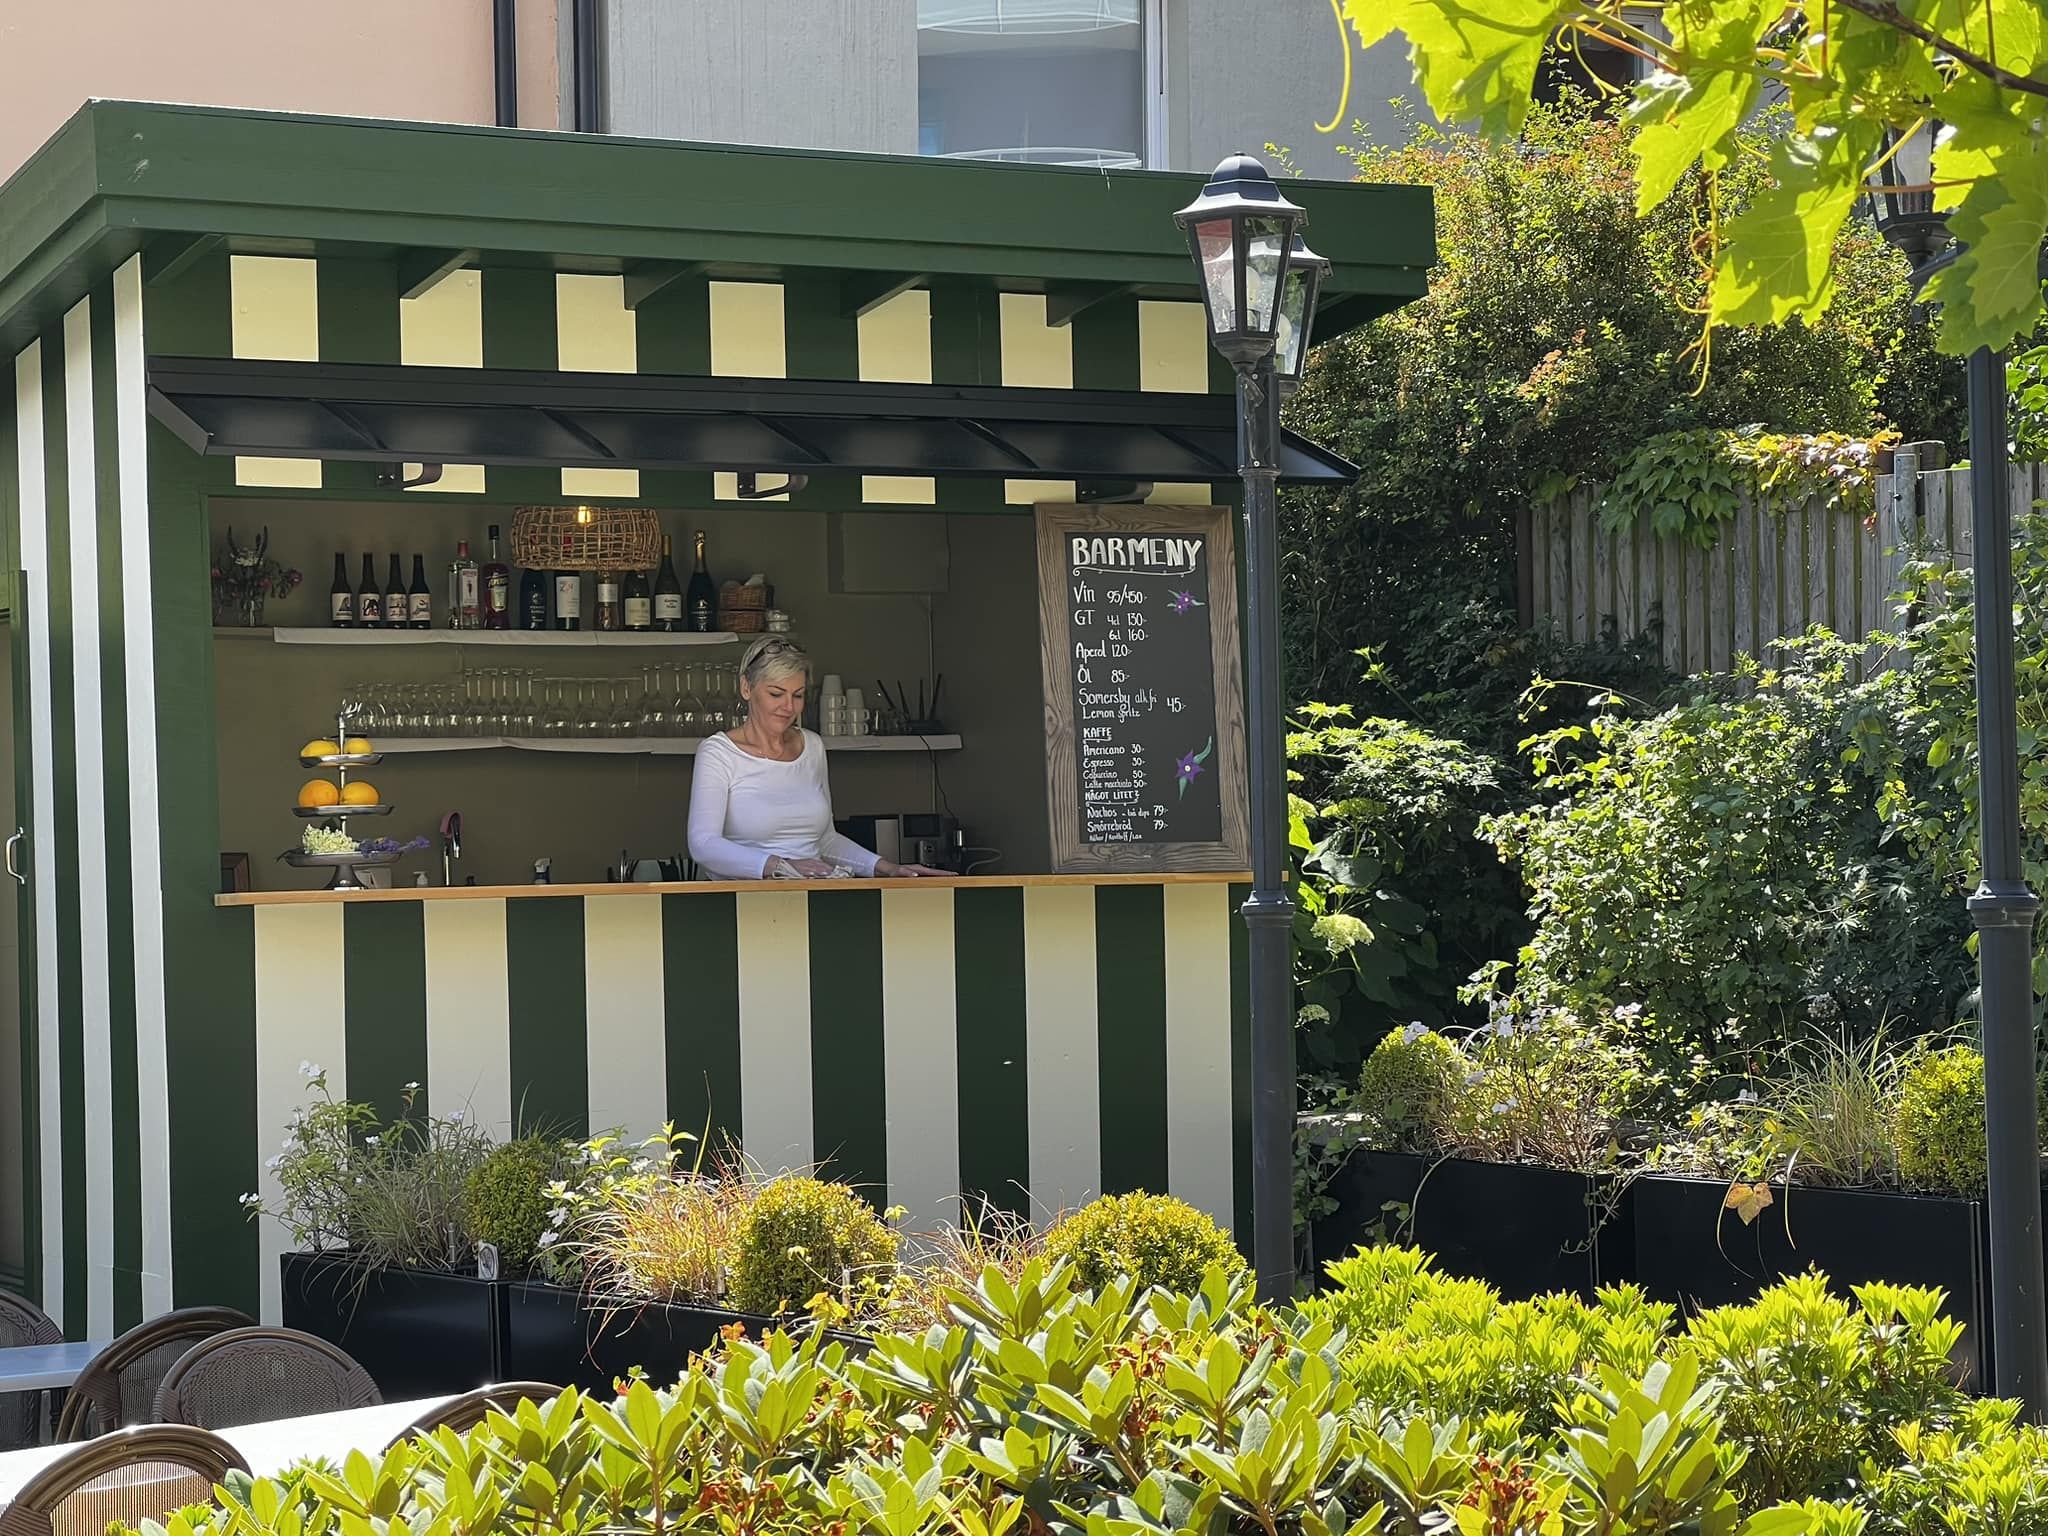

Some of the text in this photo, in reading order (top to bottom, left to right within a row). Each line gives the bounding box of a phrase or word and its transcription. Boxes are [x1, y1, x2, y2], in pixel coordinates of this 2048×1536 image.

[1072, 537, 1202, 566] BARMENY
[1073, 580, 1095, 604] Vin
[1074, 609, 1096, 625] GT
[1075, 640, 1107, 664] Aperol
[1077, 663, 1093, 684] Öl
[1078, 687, 1130, 710] Somersby
[1083, 706, 1115, 719] Lemon
[1083, 727, 1112, 738] KAFFE
[1083, 745, 1125, 756] Americano
[1083, 758, 1115, 771] Espresso
[1084, 789, 1109, 801] NÅGOT
[1087, 806, 1117, 819] Nachos
